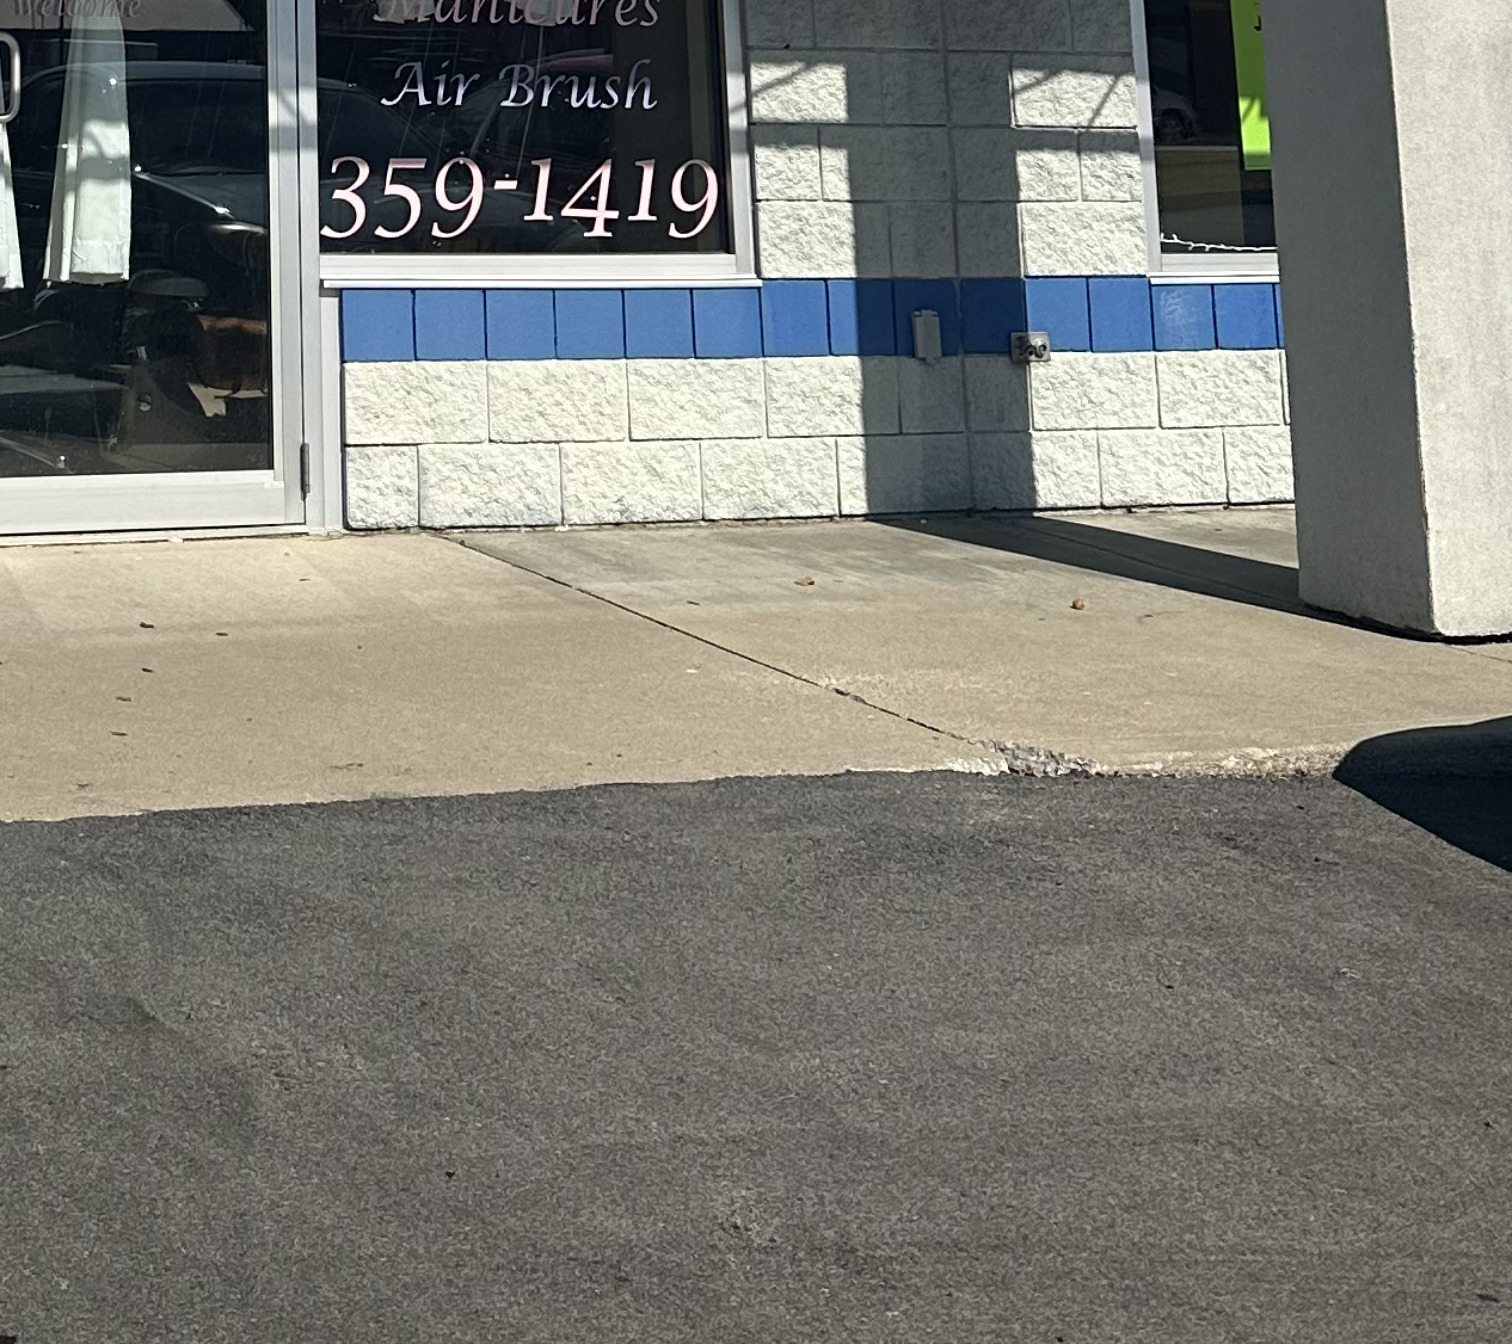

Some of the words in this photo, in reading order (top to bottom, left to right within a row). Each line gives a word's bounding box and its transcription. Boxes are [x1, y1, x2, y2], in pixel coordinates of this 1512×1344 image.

[380, 60, 481, 107] Air
[498, 59, 658, 110] Brush
[320, 156, 720, 240] 359-1419
